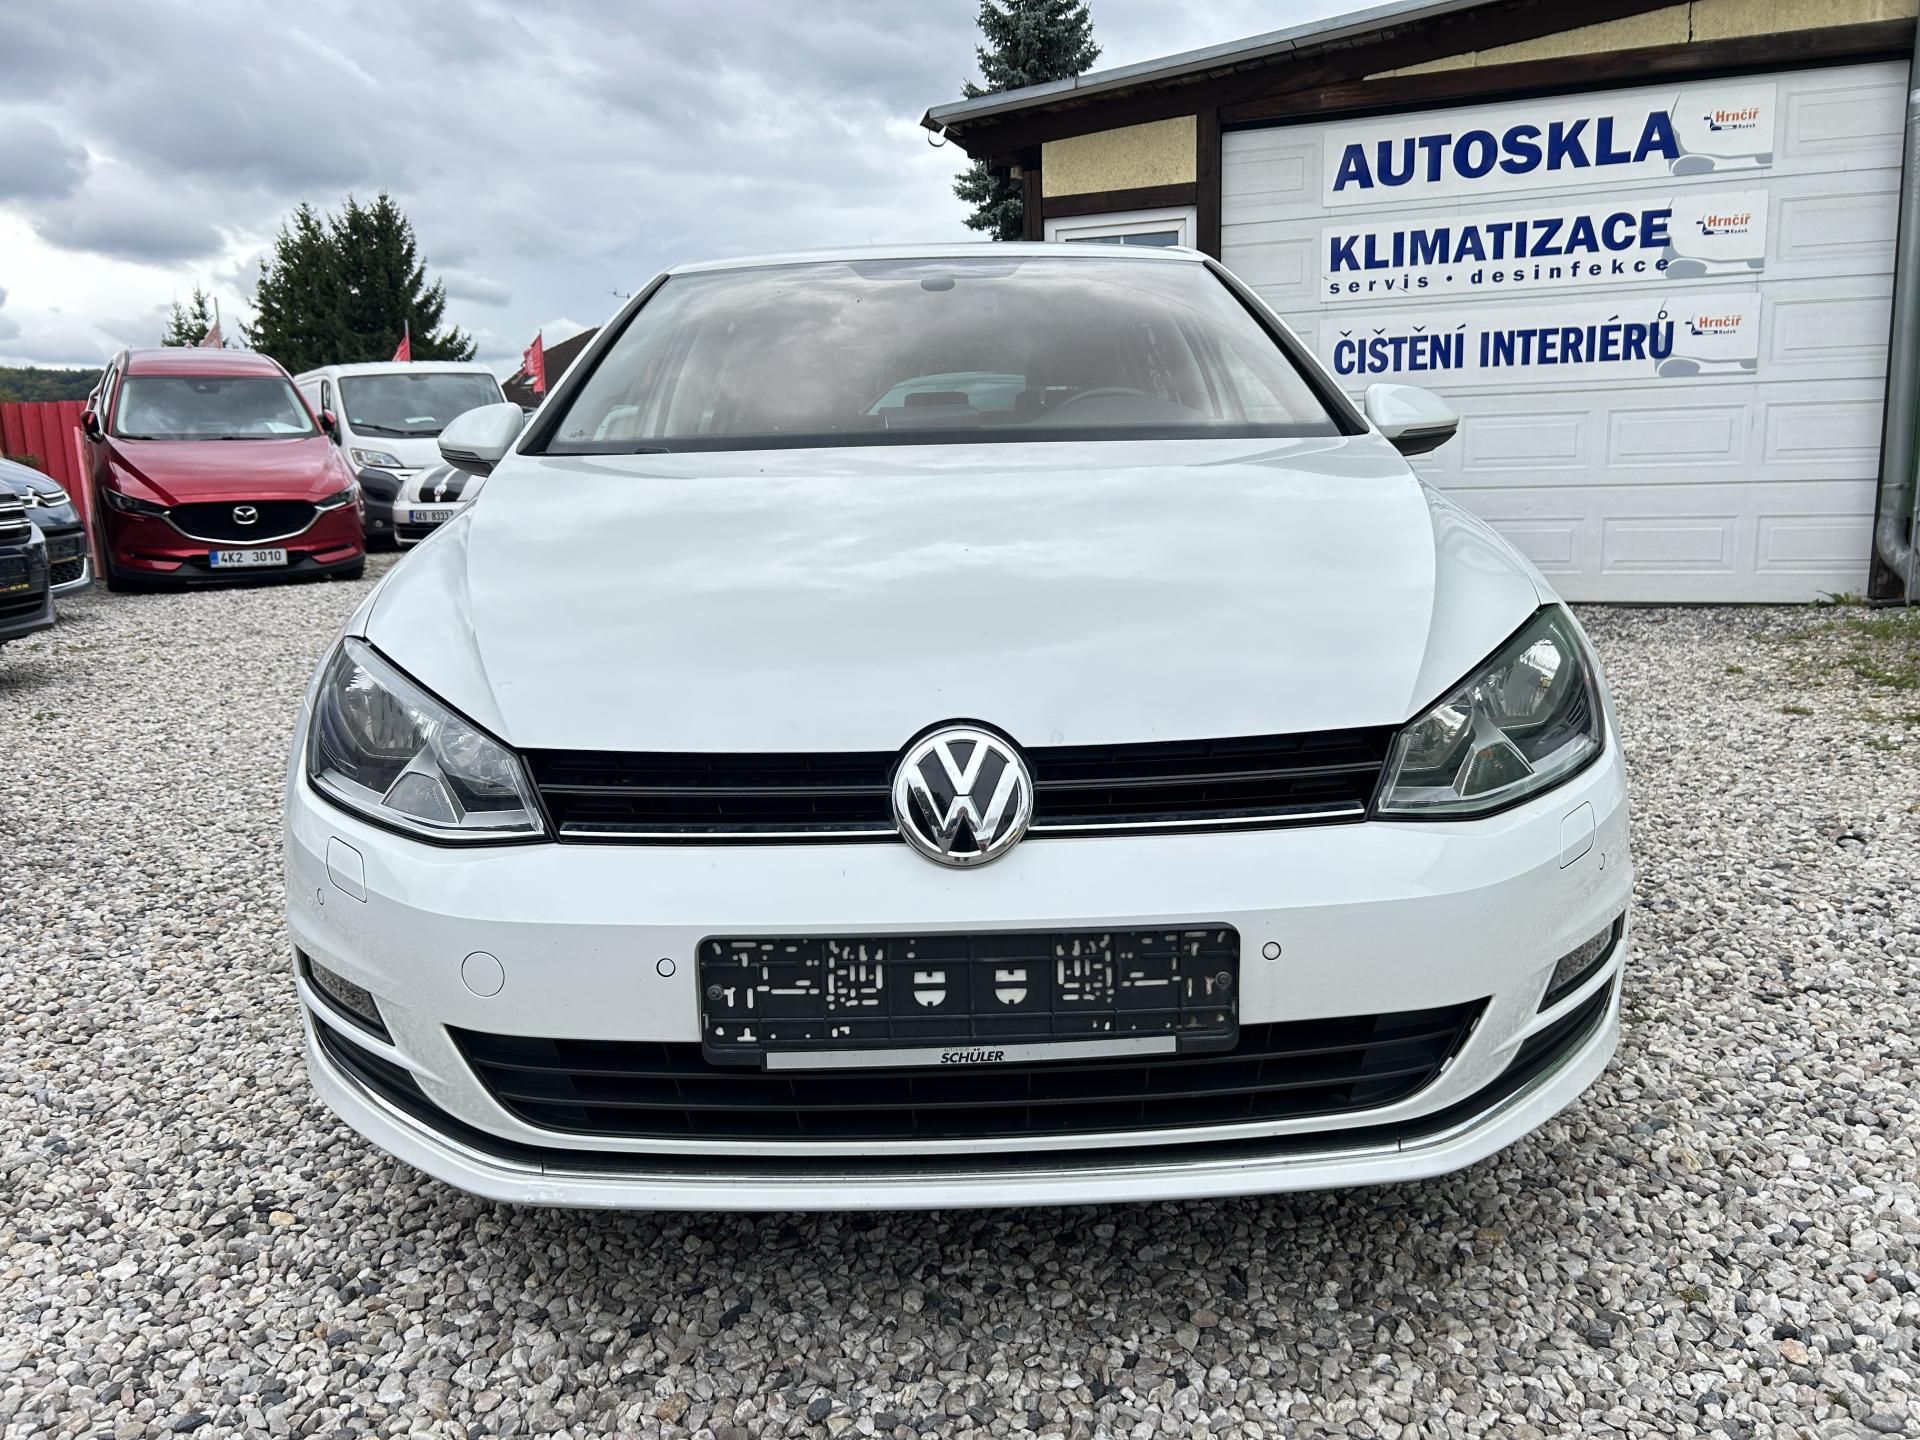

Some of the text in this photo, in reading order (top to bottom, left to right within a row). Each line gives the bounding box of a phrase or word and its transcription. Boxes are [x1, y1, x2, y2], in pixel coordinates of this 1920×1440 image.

[1715, 107, 1760, 123] Hrnčíř
[1333, 110, 1680, 192] AUTOSKLA
[1707, 212, 1752, 227] Hrnčíř
[1330, 208, 1673, 272] KLIMATIZACE
[1329, 258, 1669, 295] servis desinfekce
[1699, 314, 1742, 328] Hrnčíř
[1333, 310, 1675, 376] ČIŠTĚNÍ INTERIÉRŮ
[220, 550, 281, 564] 4K2 3010
[903, 735, 1021, 856] VW
[940, 1047, 1005, 1064] SCHÜLER
